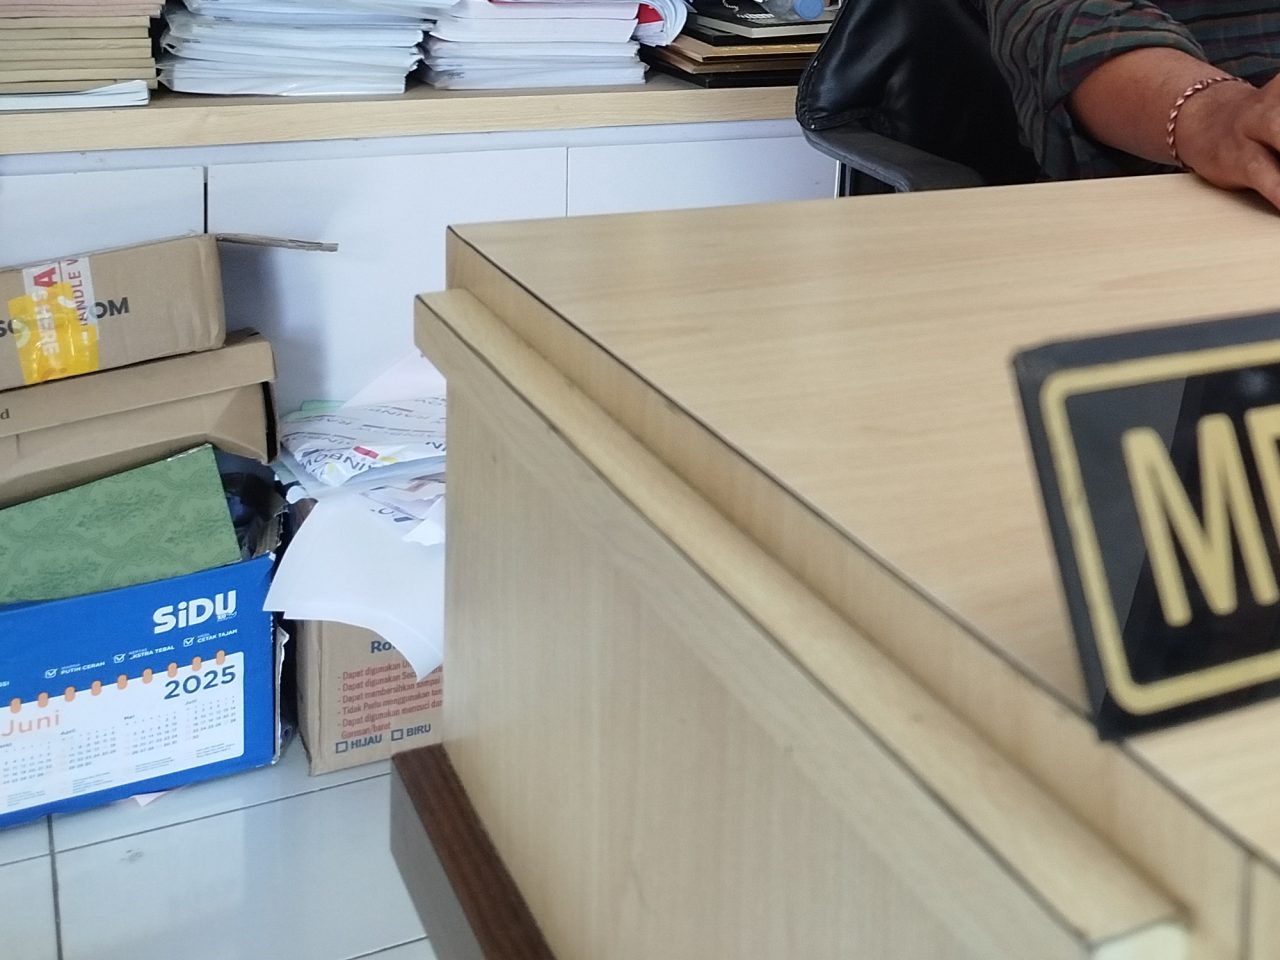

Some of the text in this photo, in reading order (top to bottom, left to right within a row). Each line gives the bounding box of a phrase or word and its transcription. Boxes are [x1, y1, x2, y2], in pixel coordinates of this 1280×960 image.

[164, 665, 236, 699] 2025
[1, 710, 60, 736] Juni
[351, 724, 431, 749] HIJAU BIRU
